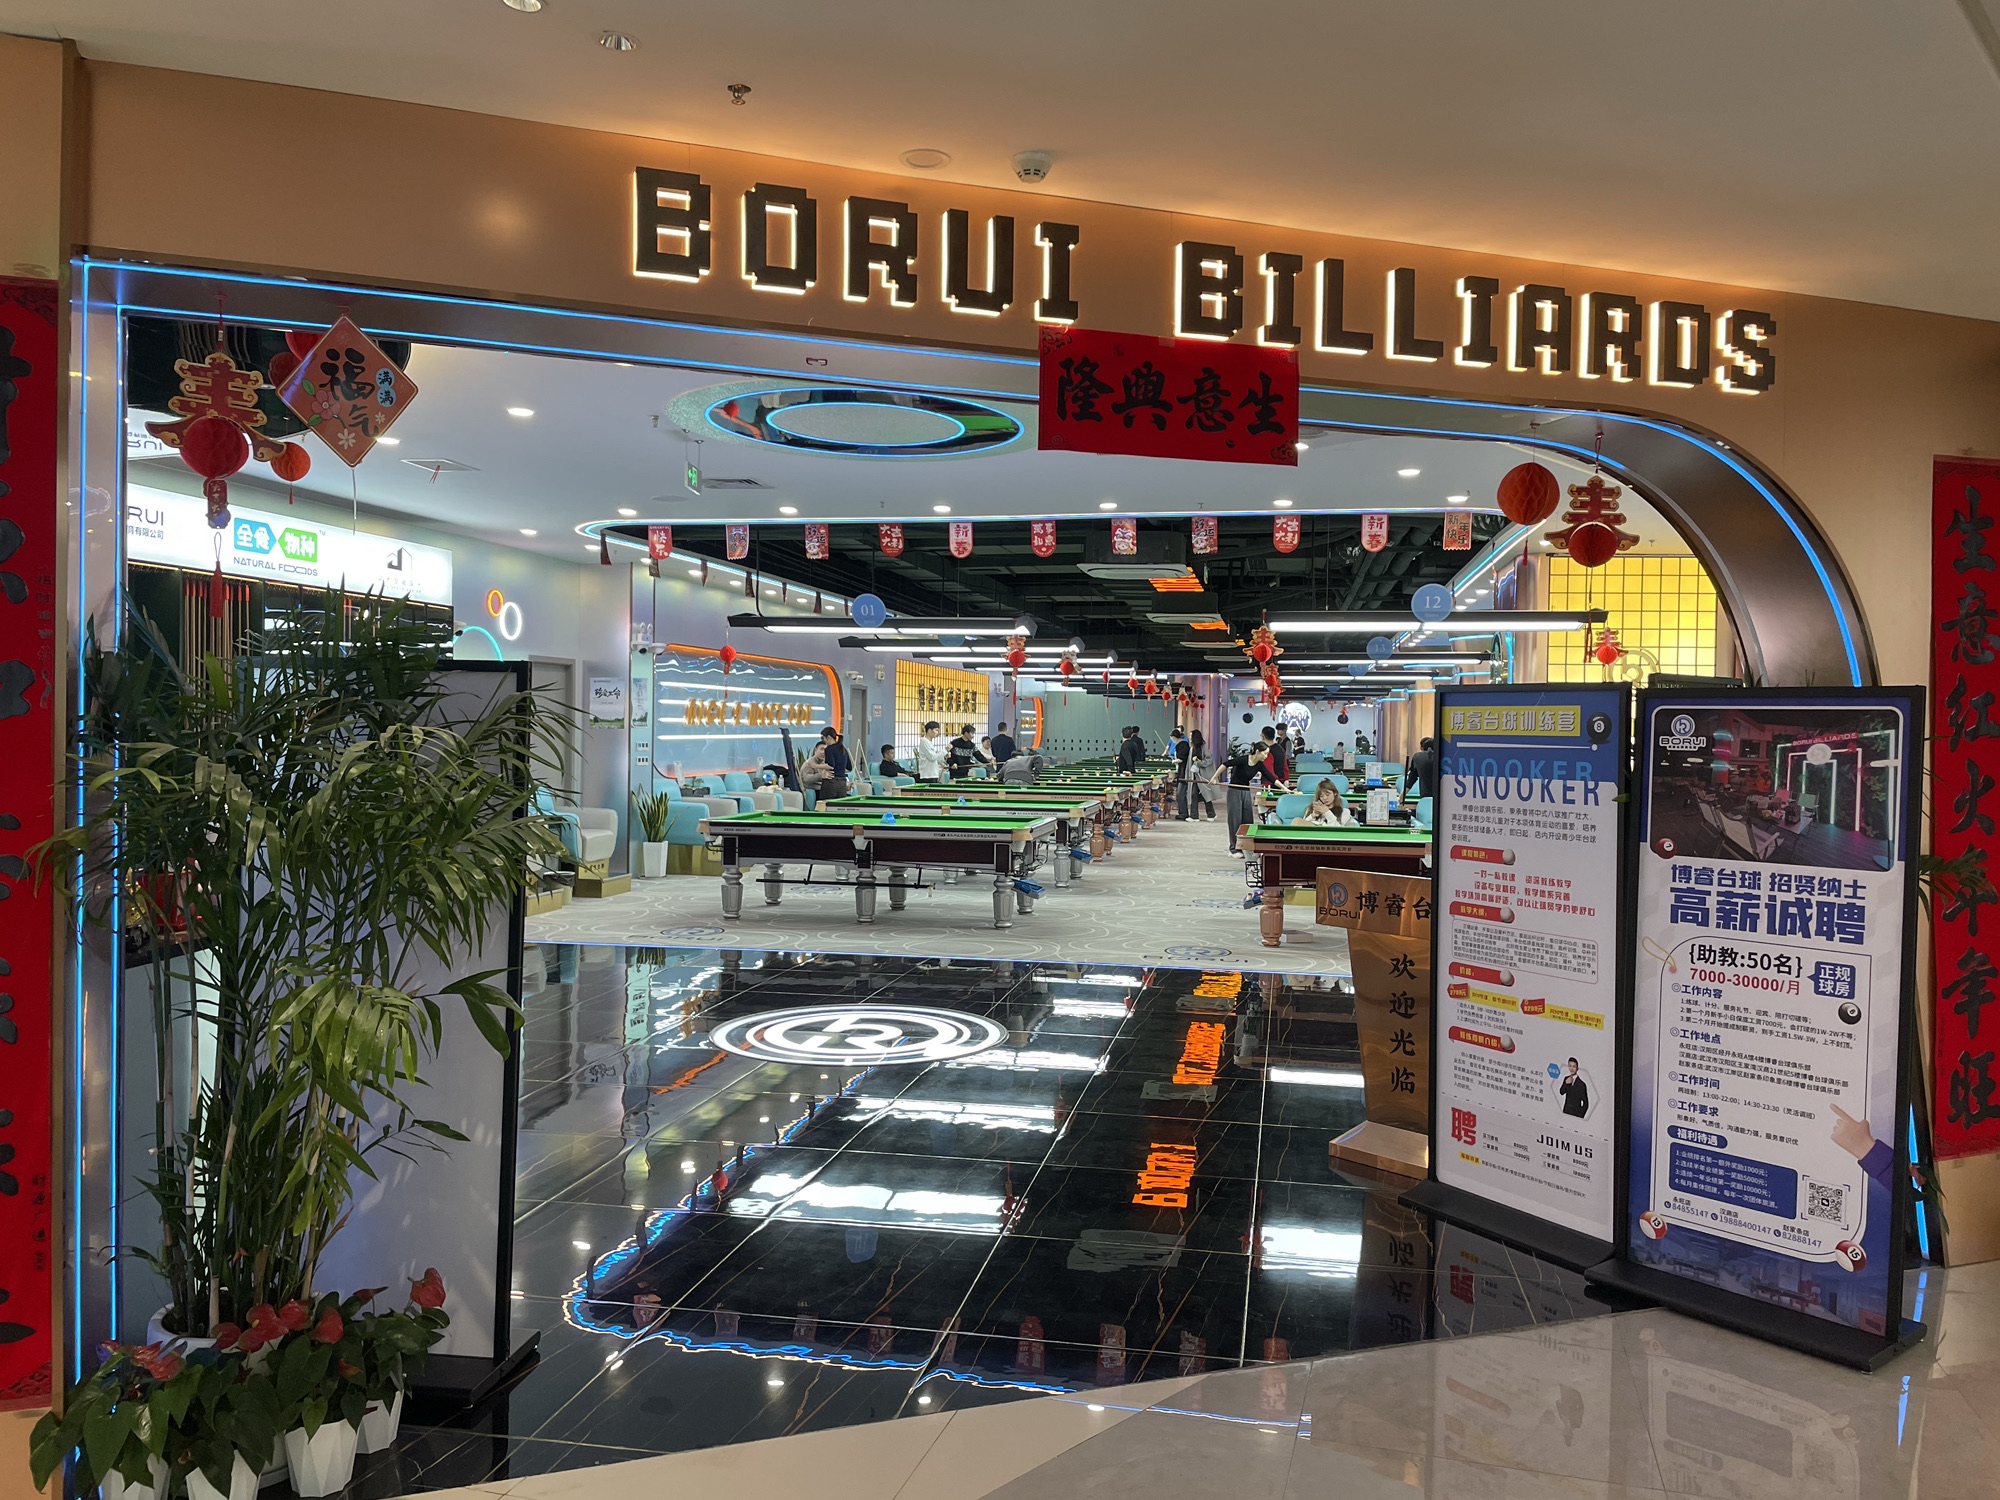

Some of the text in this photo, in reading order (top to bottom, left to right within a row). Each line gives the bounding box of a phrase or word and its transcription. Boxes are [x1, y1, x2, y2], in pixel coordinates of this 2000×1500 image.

[633, 165, 1777, 395] BORUI BILLIARDS
[233, 556, 276, 572] NATURAL
[860, 604, 876, 616] 01
[1424, 596, 1442, 609] 12
[1450, 709, 1577, 733] 博睿台球训练营
[1661, 737, 1705, 747] BORUI
[1453, 774, 1600, 806] SNOOKER
[1671, 863, 1868, 901] 博睿台球 招贤纳士
[1319, 906, 1361, 920] BORUI
[1670, 886, 1867, 946] 高薪诚聘
[1819, 963, 1851, 981] 正规
[1681, 983, 1722, 999] 工作内容
[1818, 978, 1850, 997] 球房
[1388, 953, 1419, 1095] 欢迎光临
[1679, 1027, 1721, 1044] 工作地点
[1678, 1072, 1720, 1090] 工作时间
[1677, 1099, 1719, 1118] 工作要求
[1451, 1106, 1476, 1147] 聘
[1676, 1126, 1718, 1146] 福利待遇
[1574, 1143, 1592, 1158] US
[1671, 1202, 1708, 1219] 84855147
[1719, 1214, 1771, 1235] 19888400147
[1782, 1230, 1822, 1249] 82888147
